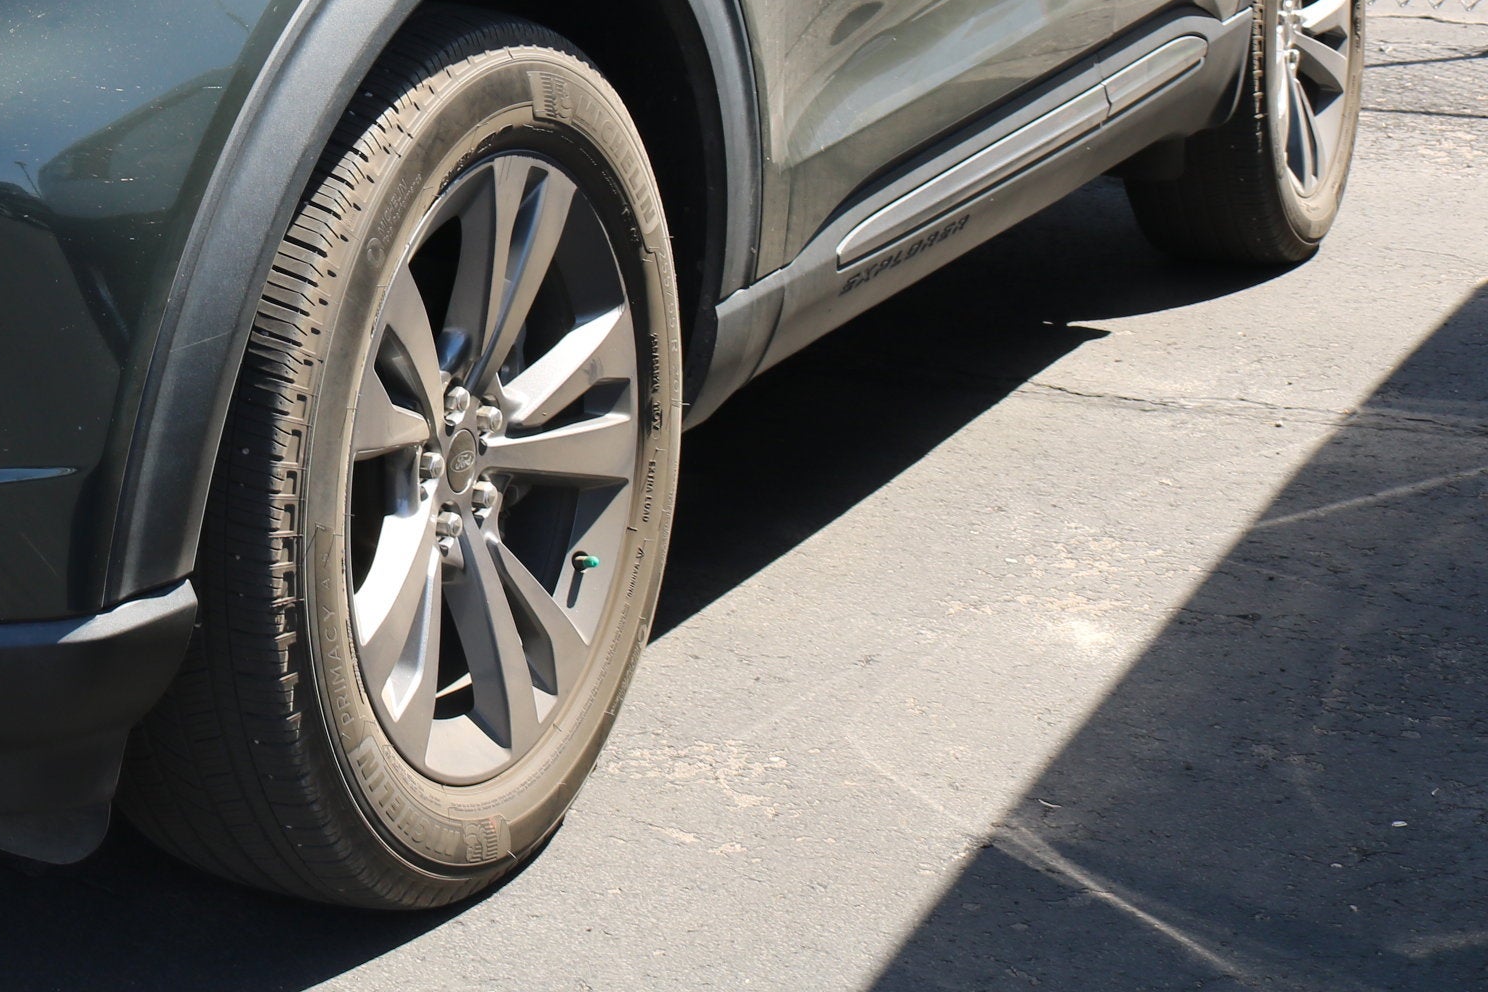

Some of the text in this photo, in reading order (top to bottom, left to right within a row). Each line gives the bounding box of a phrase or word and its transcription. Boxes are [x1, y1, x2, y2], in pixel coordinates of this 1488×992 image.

[573, 93, 657, 225] MICHELIN
[838, 214, 971, 296] EXPLORER
[642, 460, 657, 523] EXTRA LOAD
[323, 606, 355, 727] PRIMACY
[356, 748, 462, 857] MICHELIN
